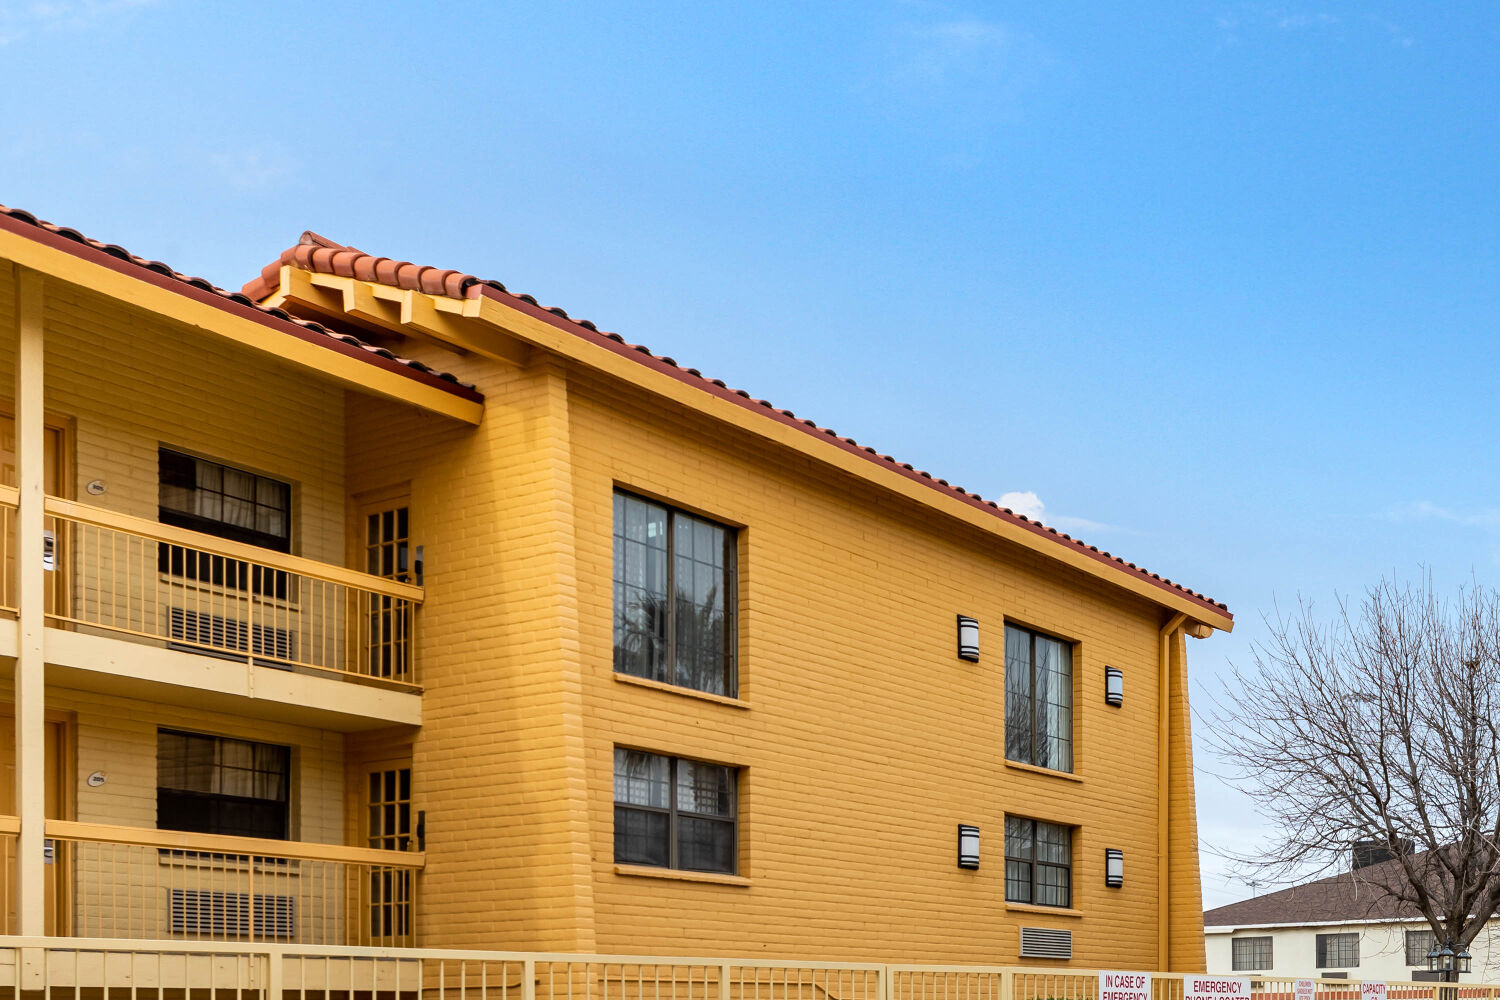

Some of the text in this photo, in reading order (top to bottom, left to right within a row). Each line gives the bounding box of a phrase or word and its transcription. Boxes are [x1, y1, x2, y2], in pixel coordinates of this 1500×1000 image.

[1105, 975, 1146, 988] IN CASE OF
[1193, 980, 1242, 993] EMERGENCY
[1362, 983, 1386, 994] CAPACITY
